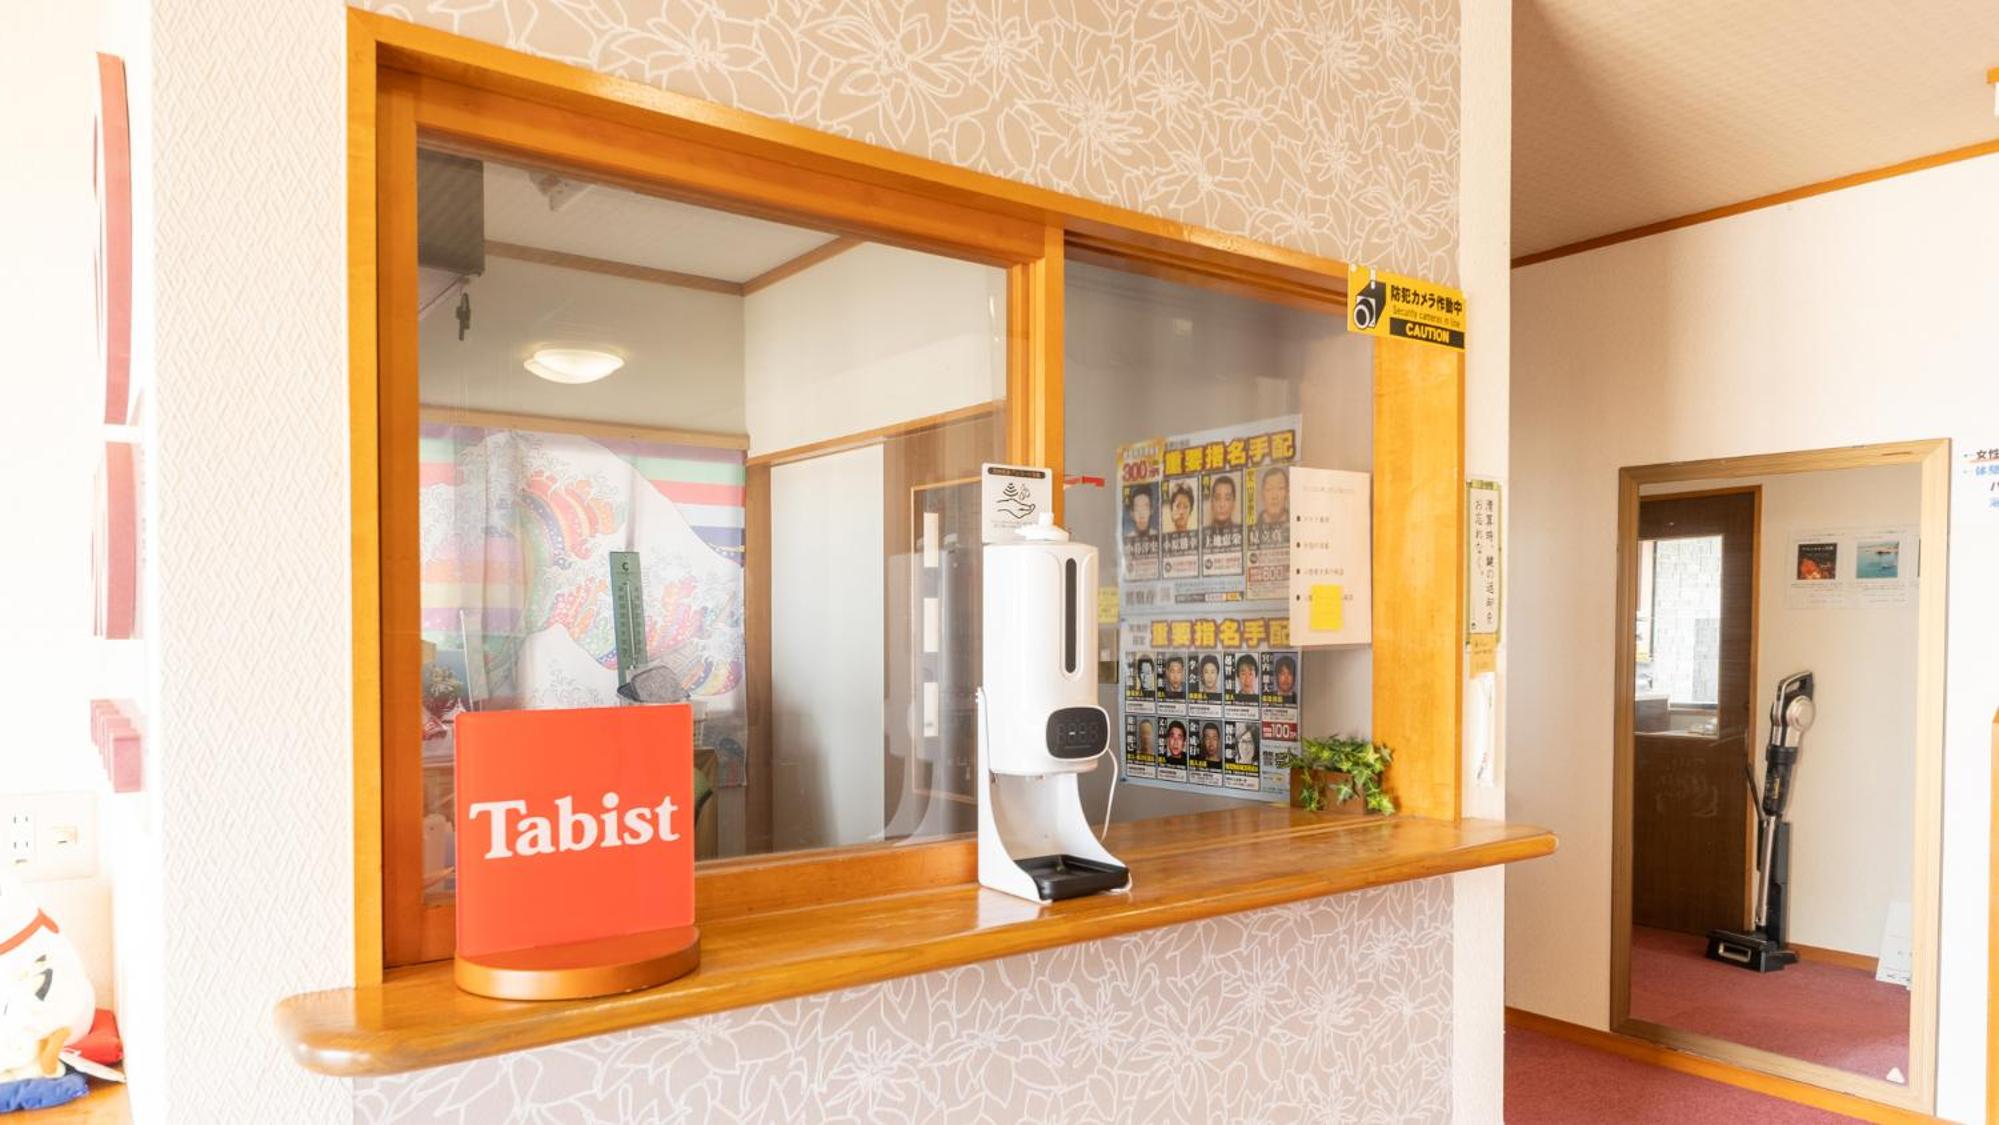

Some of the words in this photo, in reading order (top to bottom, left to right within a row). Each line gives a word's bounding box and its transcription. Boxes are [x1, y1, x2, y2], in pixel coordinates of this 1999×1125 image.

[1391, 285, 1462, 316] 防犯カメラ作動中
[1405, 322, 1450, 343] CAUTION
[1163, 429, 1296, 476] 重要指名手配
[1151, 617, 1289, 649] 重要指名手配
[469, 791, 681, 860] Tabist
